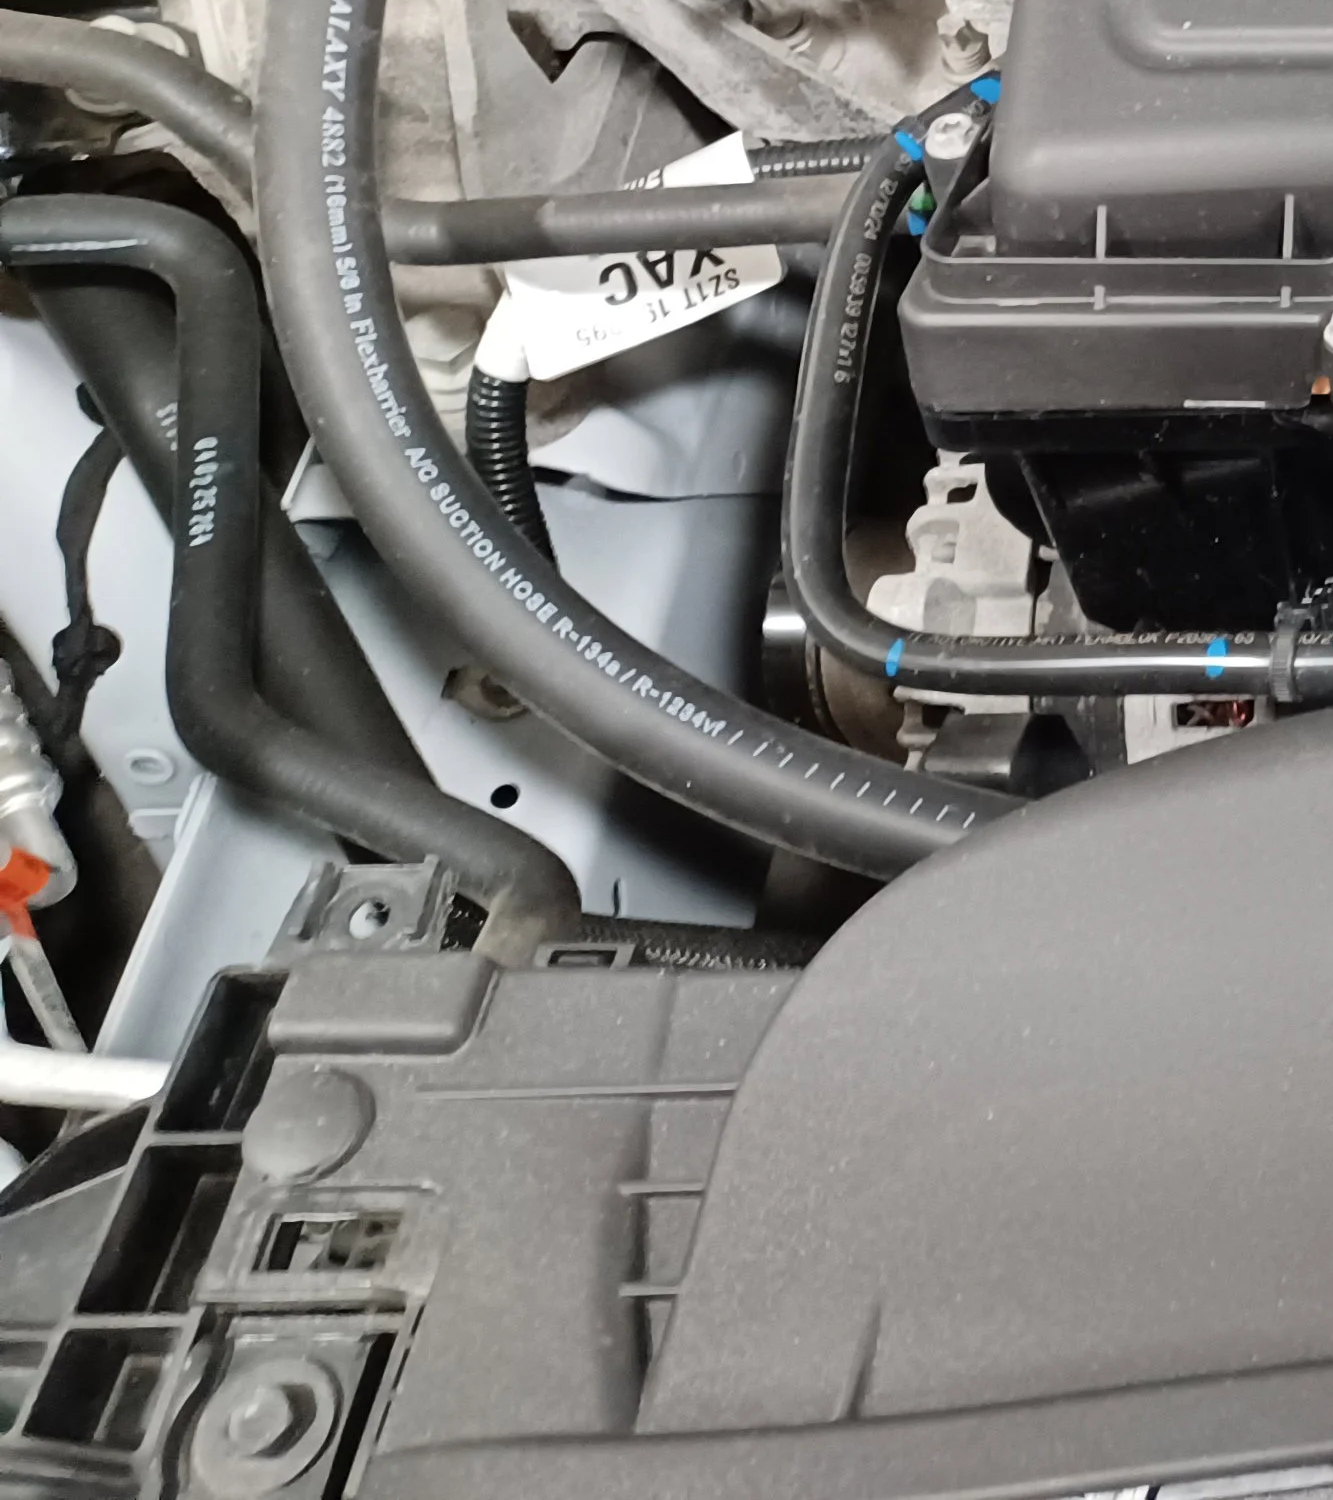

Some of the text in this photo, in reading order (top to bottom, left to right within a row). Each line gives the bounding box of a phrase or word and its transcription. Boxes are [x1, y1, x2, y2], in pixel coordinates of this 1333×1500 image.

[323, 174, 353, 253] (16mm)
[430, 482, 507, 573] SUCTION
[500, 567, 559, 624] HOSE
